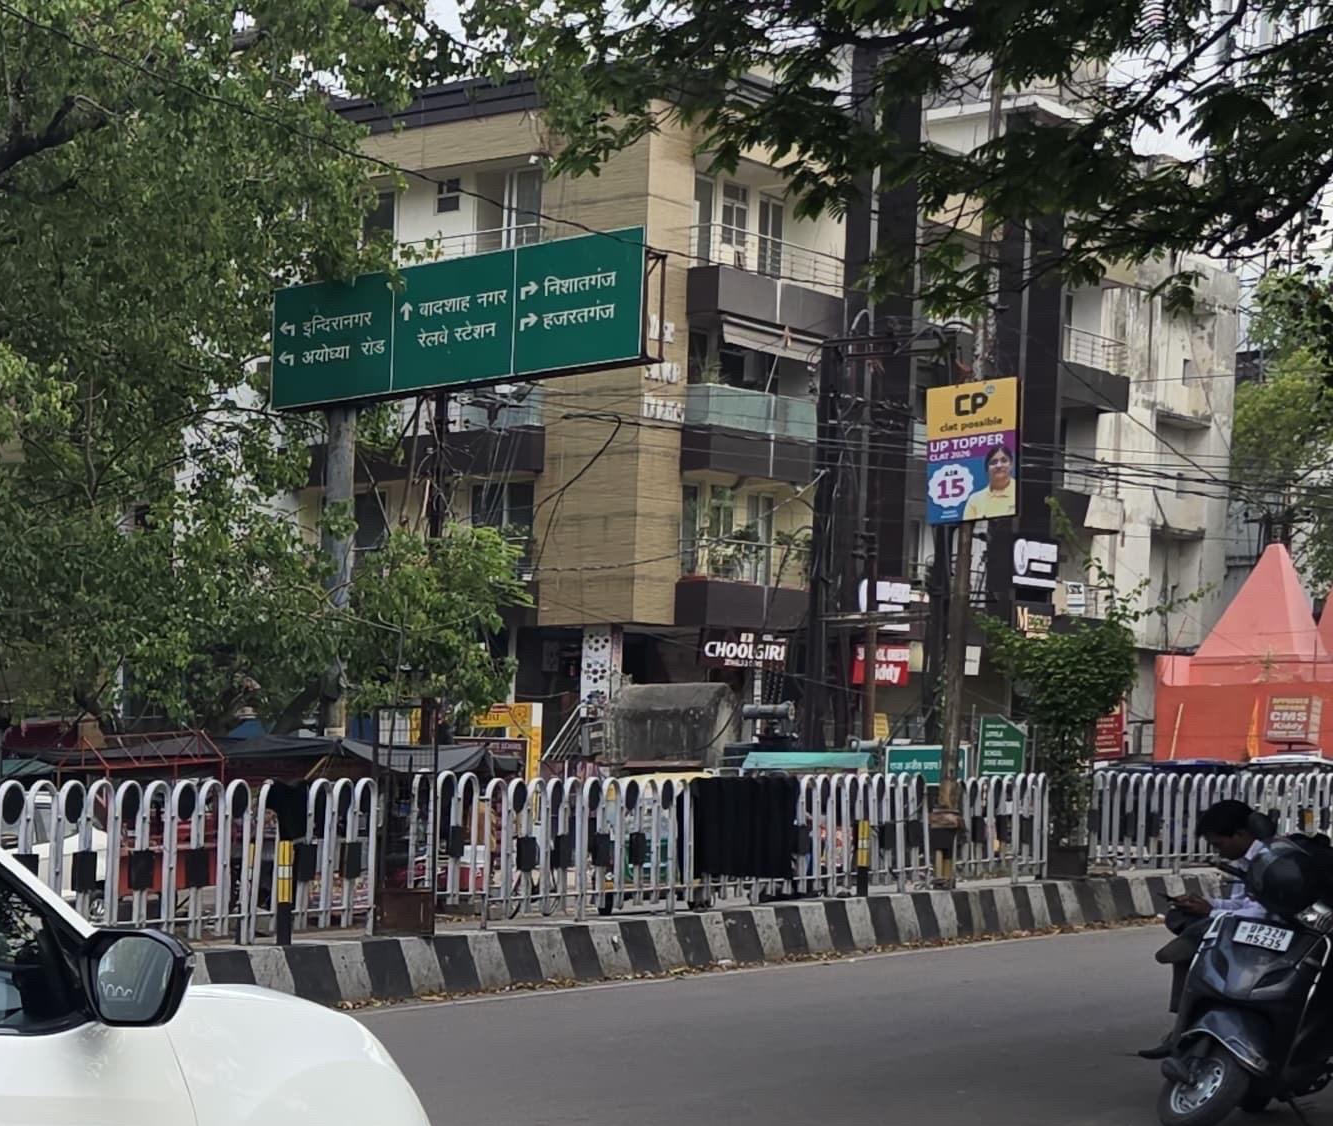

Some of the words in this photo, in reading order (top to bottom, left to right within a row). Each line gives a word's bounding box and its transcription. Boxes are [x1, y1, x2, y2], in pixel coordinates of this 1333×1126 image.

[544, 267, 617, 296] निशातगंज
[476, 289, 508, 307] नगर
[302, 312, 372, 338] इन्दिरानगर
[542, 299, 615, 330] हजरतगंज
[417, 325, 449, 347] रेलवे
[454, 320, 496, 341] स्टेशन
[361, 336, 386, 355] रोड
[954, 391, 988, 416] CP
[940, 422, 958, 433] clat
[960, 417, 1003, 431] possible
[929, 441, 949, 453] UP
[952, 433, 1005, 450] TOPPER
[929, 452, 949, 462] CLAT
[937, 478, 965, 500] 15
